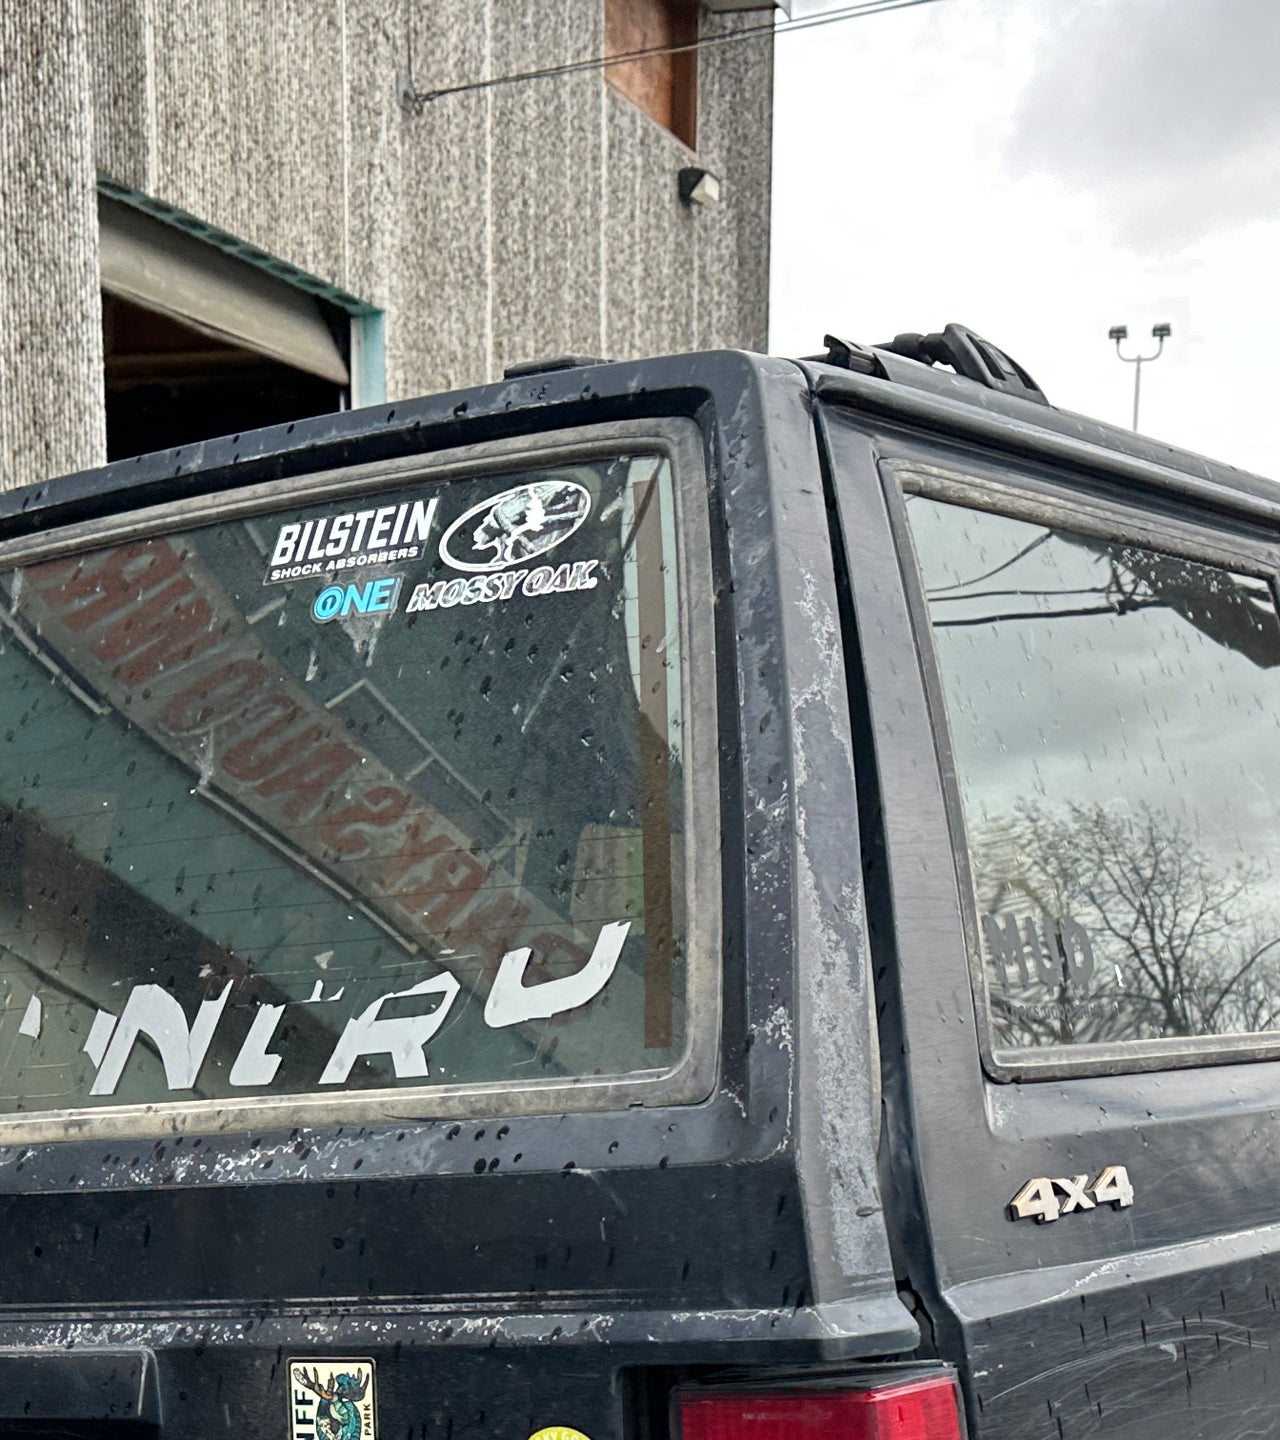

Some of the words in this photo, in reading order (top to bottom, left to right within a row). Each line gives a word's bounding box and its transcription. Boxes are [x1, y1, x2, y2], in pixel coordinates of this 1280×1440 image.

[271, 498, 439, 567] BILSTEIN
[271, 562, 322, 581] SHOCK
[325, 546, 419, 571] ABSORBERS
[314, 578, 396, 620] ONE
[406, 569, 528, 613] MOSSY
[1005, 1165, 1134, 1223] 4x4
[363, 1403, 373, 1436] PARK
